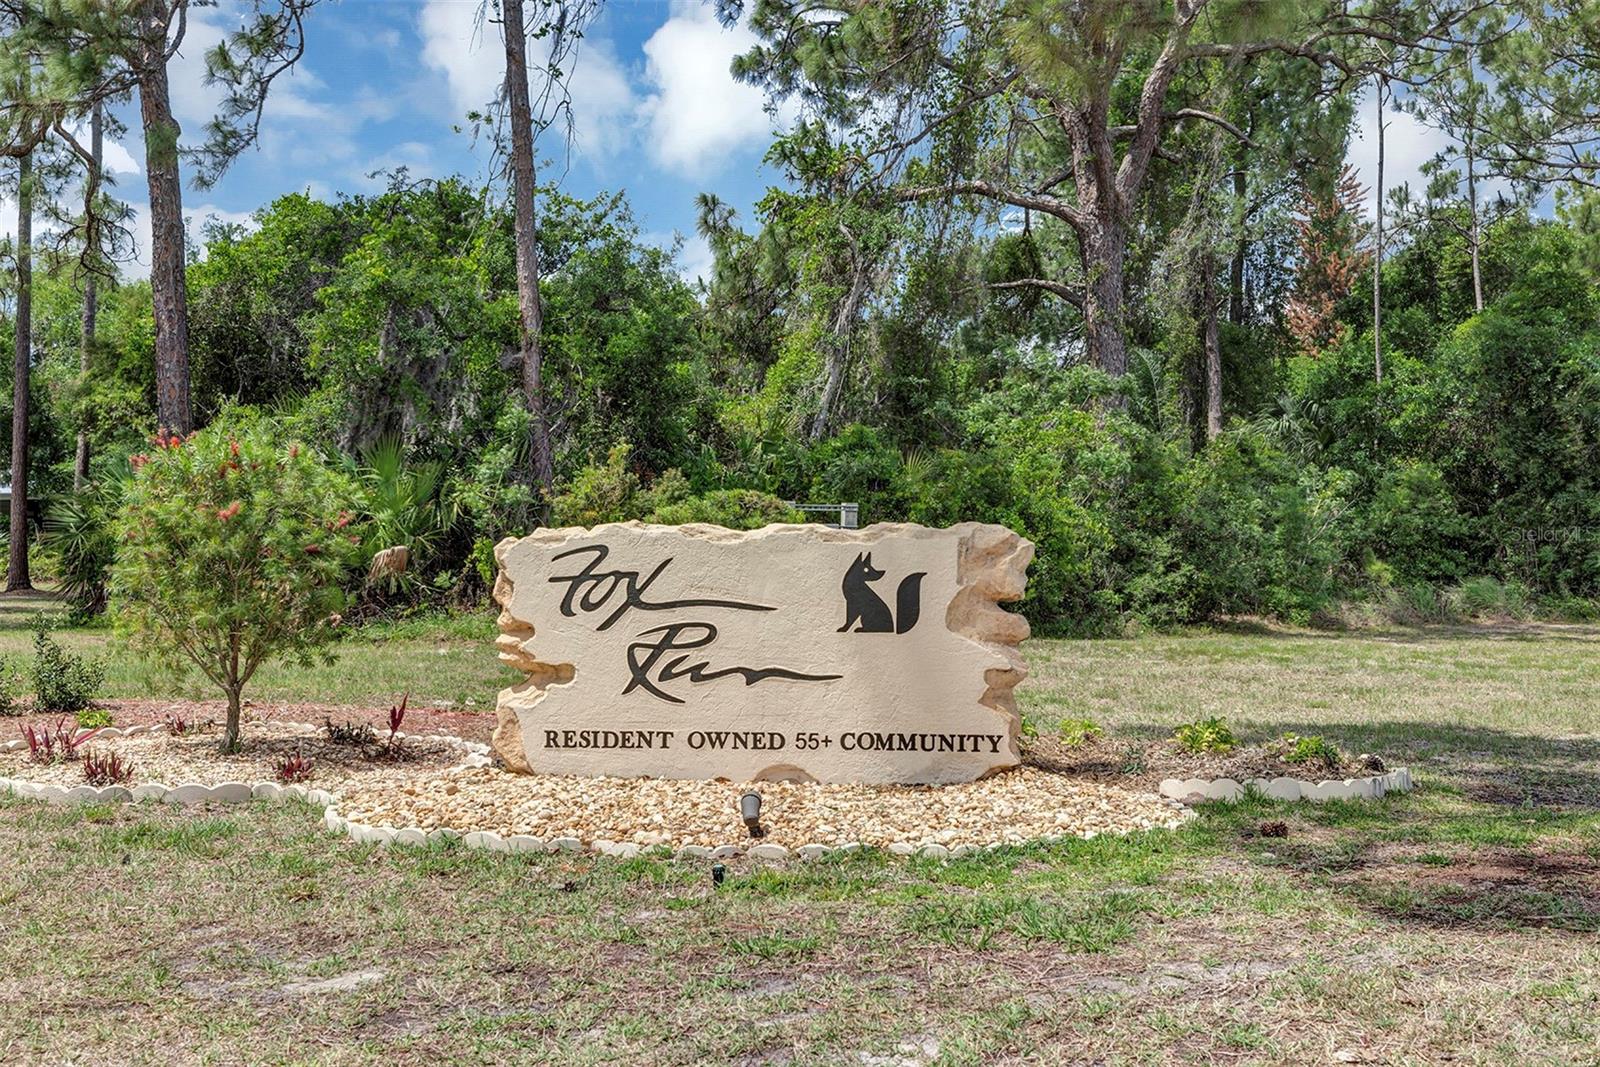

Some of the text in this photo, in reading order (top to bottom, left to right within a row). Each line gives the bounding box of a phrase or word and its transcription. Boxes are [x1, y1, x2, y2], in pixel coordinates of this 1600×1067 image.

[548, 544, 777, 632] Fox
[621, 621, 843, 704] Run
[544, 730, 1004, 754] RESIDENT OWNED 55+ COMMUNITY
